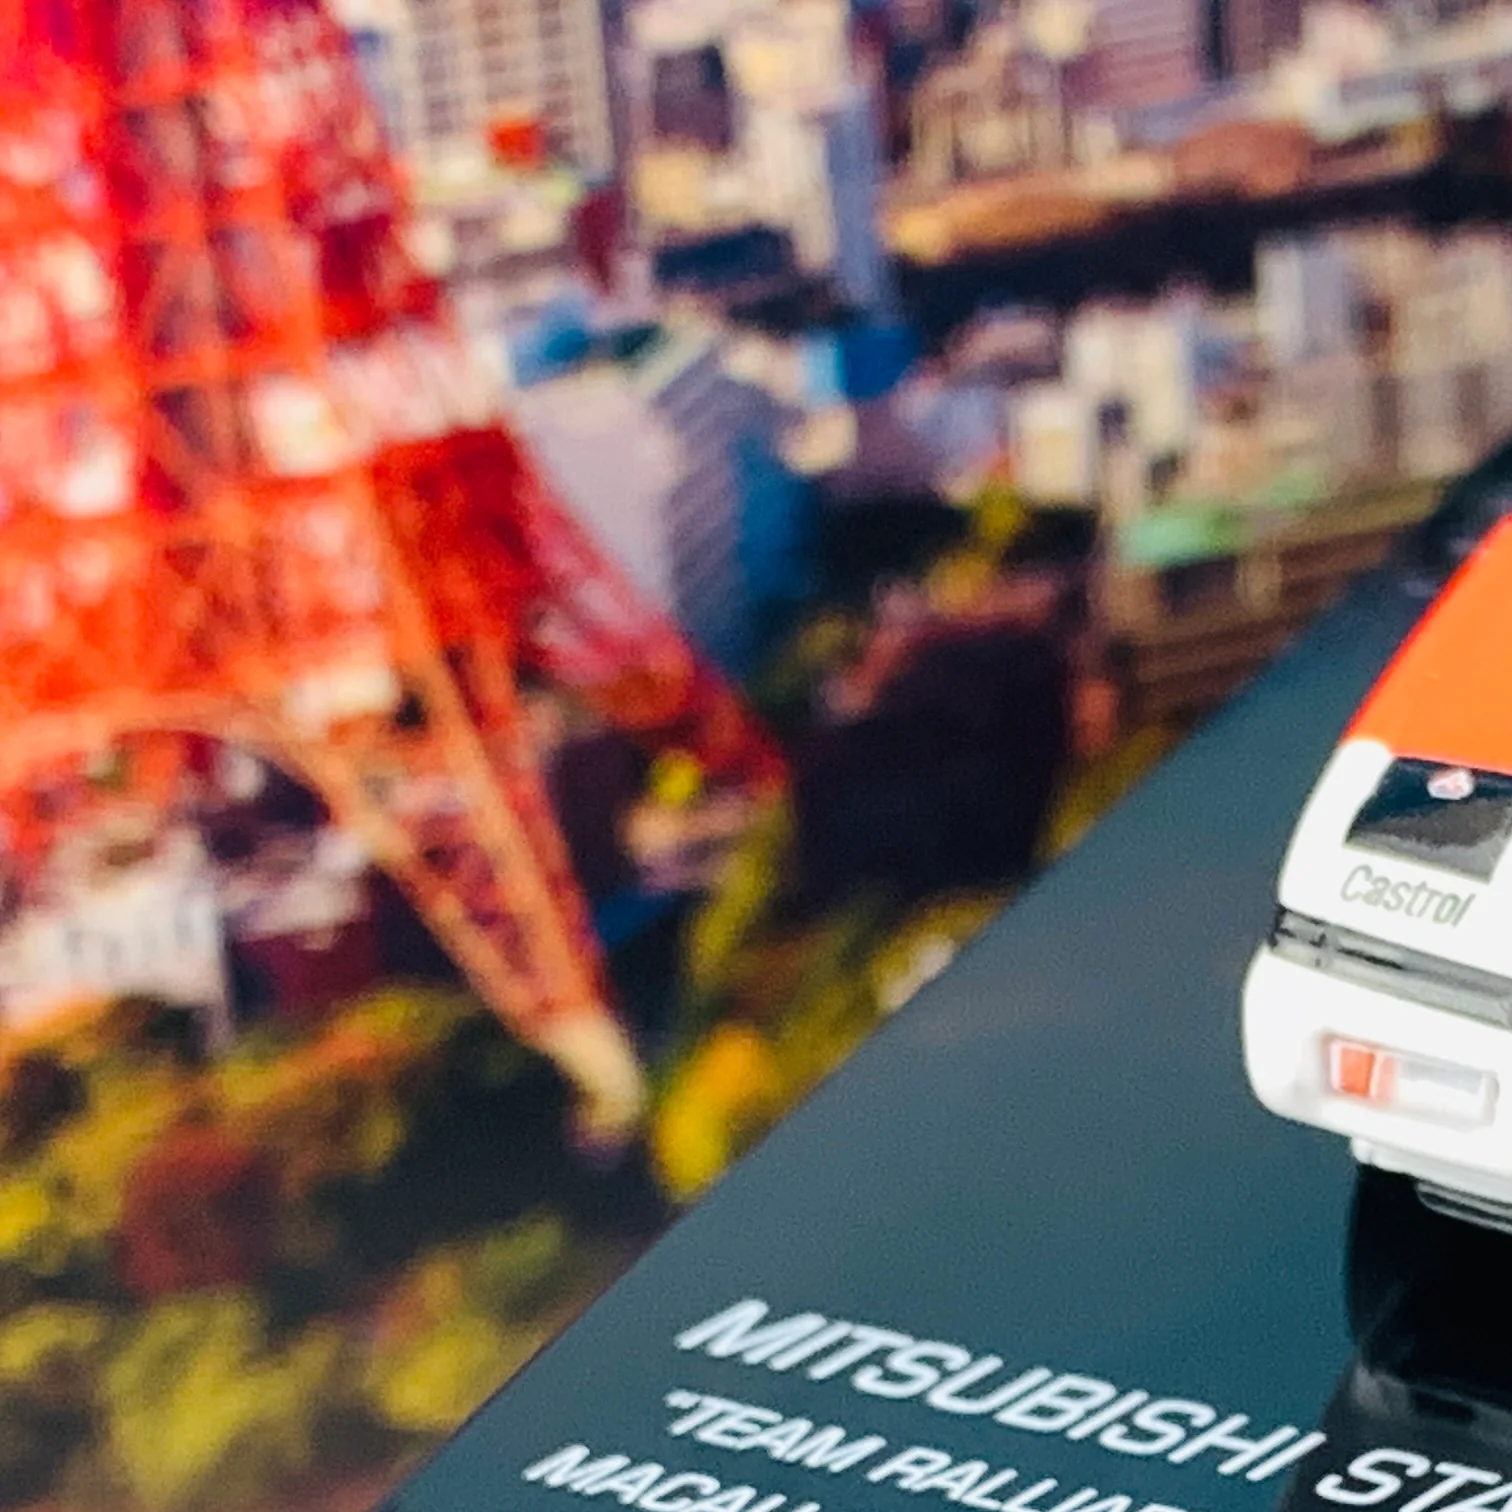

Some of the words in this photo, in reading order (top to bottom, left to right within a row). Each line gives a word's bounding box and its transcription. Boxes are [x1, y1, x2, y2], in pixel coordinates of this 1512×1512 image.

[1340, 865, 1476, 928] Castrol
[663, 1389, 887, 1474] "TEAM
[675, 1298, 1327, 1483] MITSUBISHI
